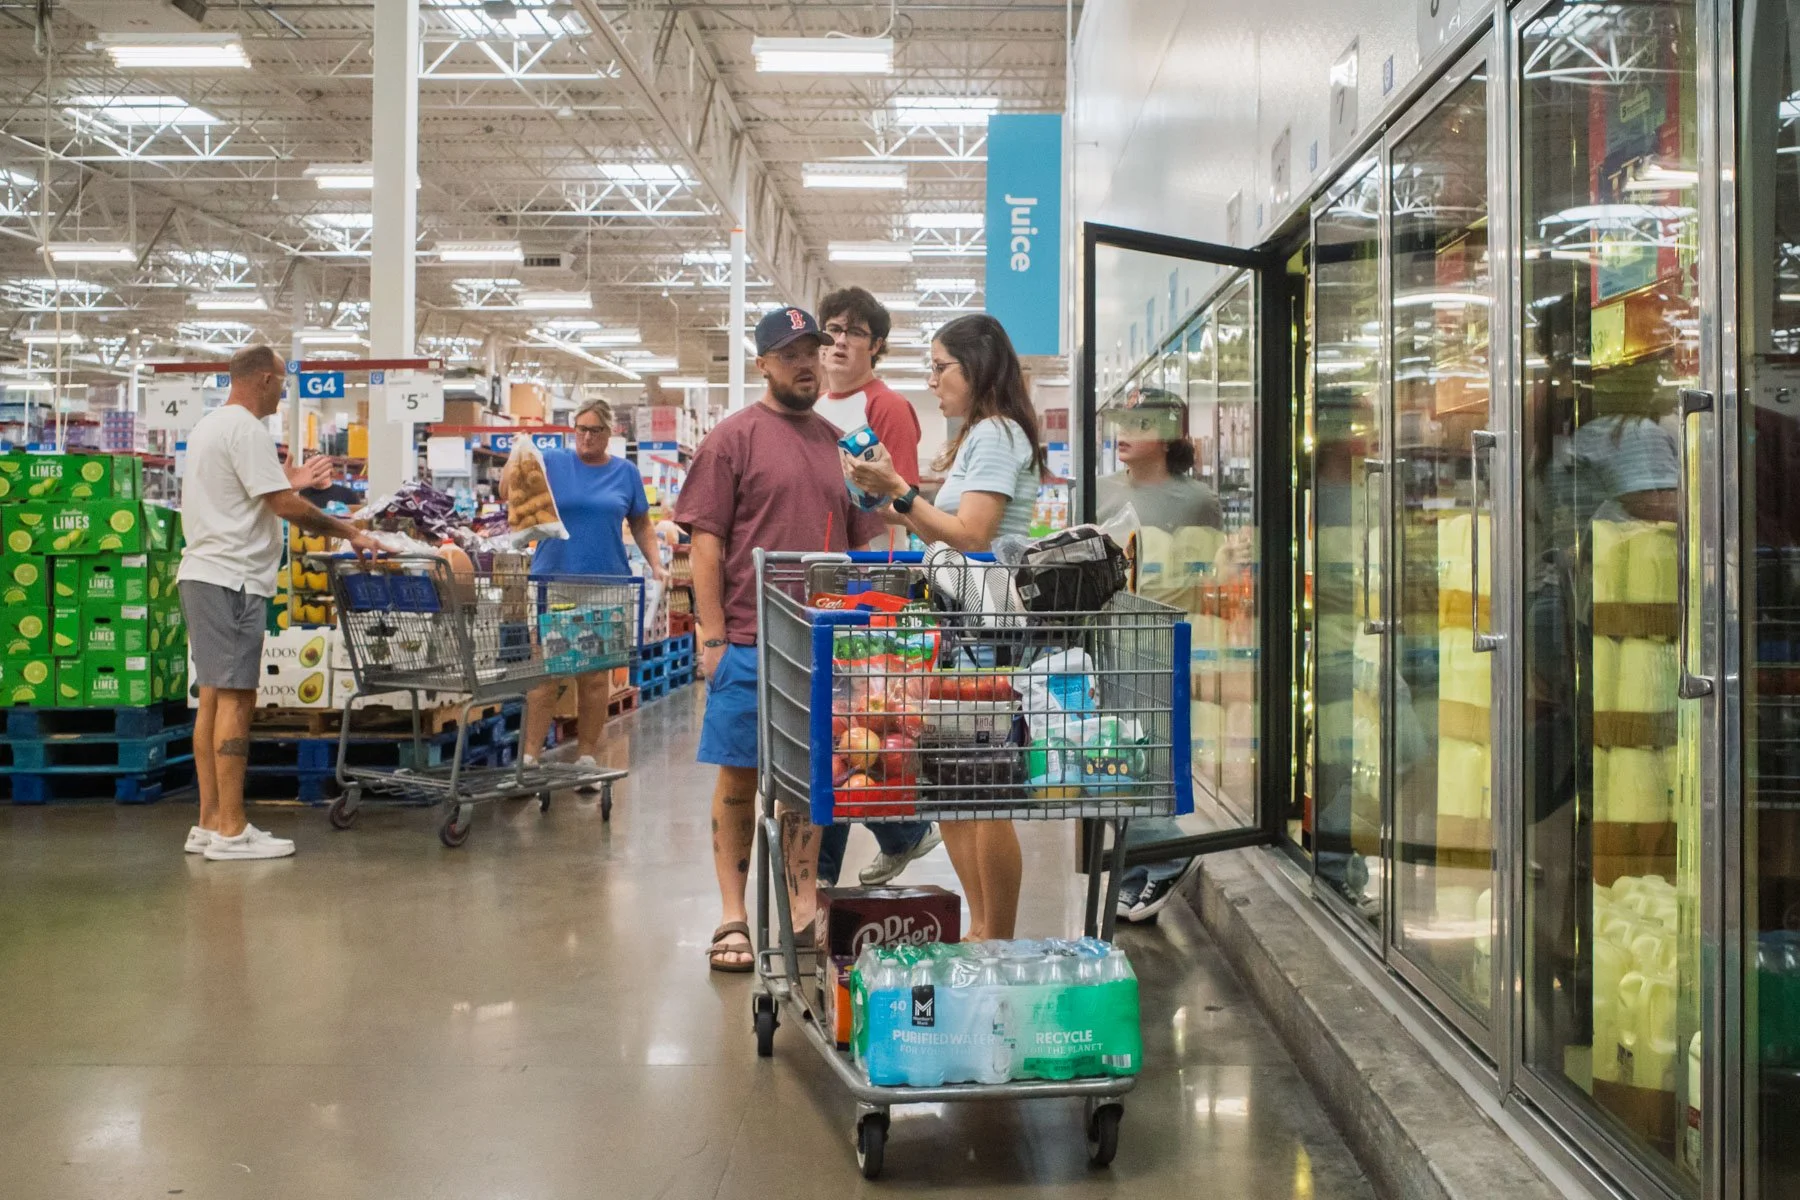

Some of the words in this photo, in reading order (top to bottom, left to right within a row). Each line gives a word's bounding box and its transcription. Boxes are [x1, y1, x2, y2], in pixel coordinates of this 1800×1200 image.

[1004, 193, 1038, 272] Juice
[786, 309, 806, 330] B
[307, 377, 336, 394] G4
[536, 436, 557, 449] G4
[30, 465, 63, 478] LIMES
[53, 515, 90, 530] LIMES
[89, 578, 114, 589] LIMES
[90, 630, 115, 642] LIMES
[263, 648, 297, 658] ADOS
[93, 679, 119, 690] LIMES
[257, 688, 296, 696] ADOS
[884, 915, 915, 942] Dr
[889, 1000, 907, 1013] 40
[892, 1030, 948, 1045] PURIFIED
[950, 1033, 994, 1045] WATER
[1036, 1030, 1093, 1044] RECYCLE
[1047, 1046, 1066, 1055] THE
[1068, 1043, 1104, 1053] PLANET
